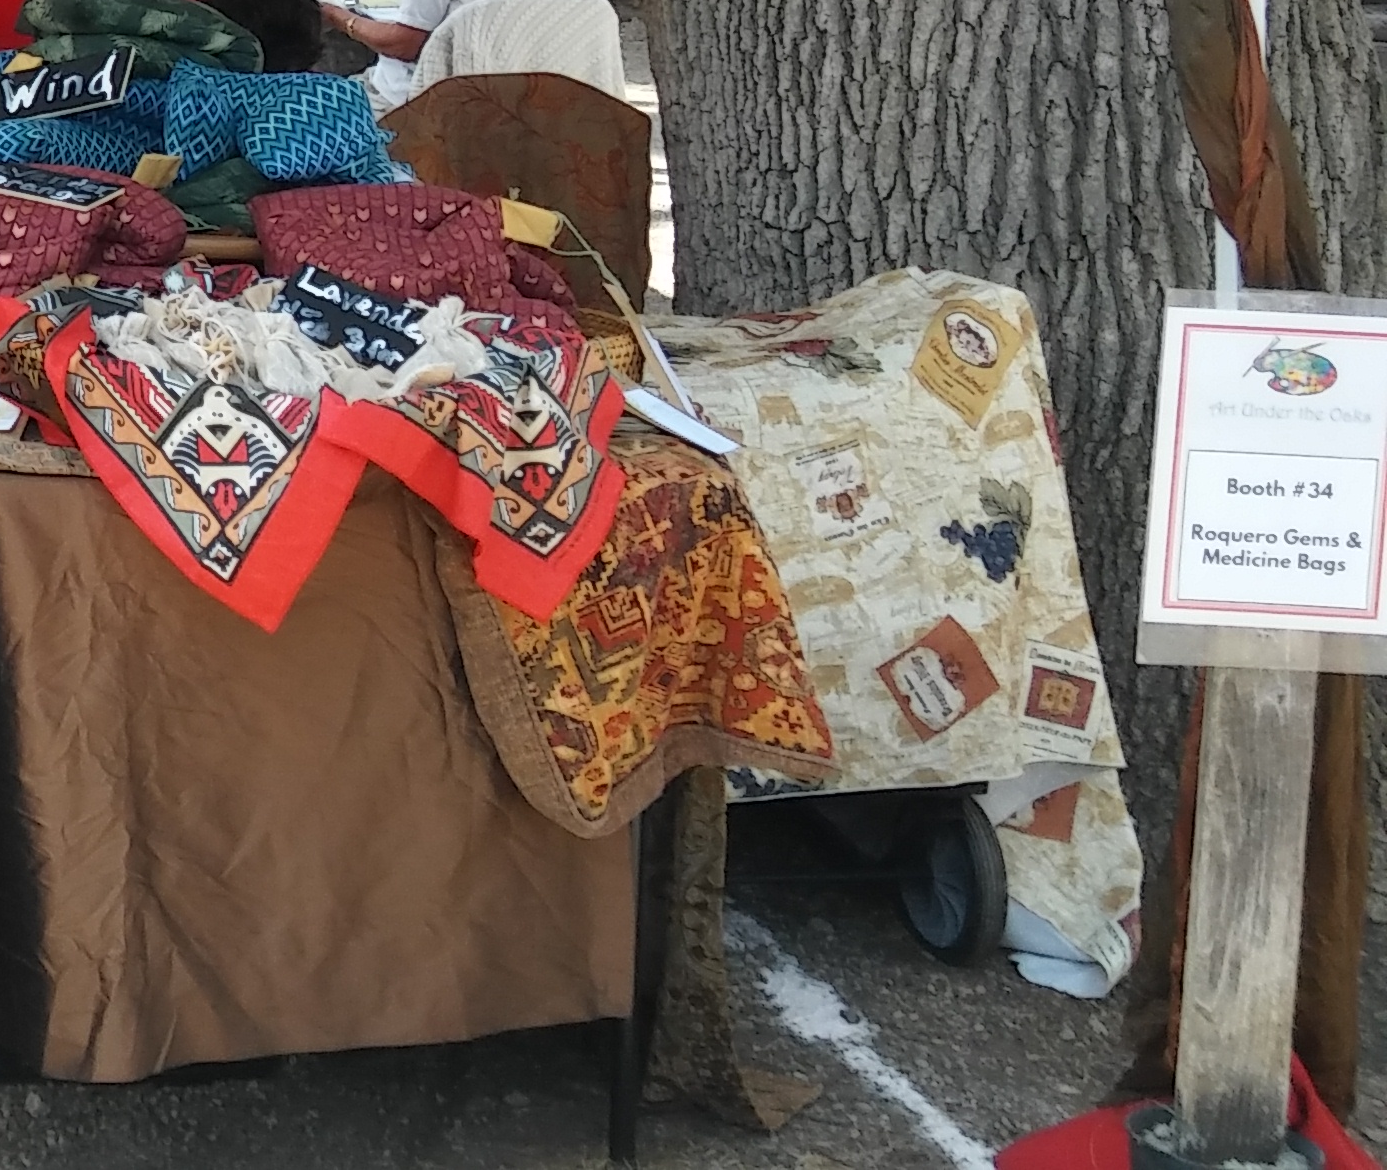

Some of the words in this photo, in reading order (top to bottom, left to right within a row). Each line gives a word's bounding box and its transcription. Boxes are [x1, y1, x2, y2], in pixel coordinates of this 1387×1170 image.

[1, 52, 115, 113] Wind
[1227, 477, 1286, 497] Booth
[1293, 481, 1334, 500] #34
[1191, 523, 1278, 547] Roquero
[1283, 528, 1340, 548] Gems
[1345, 531, 1363, 549] &
[1202, 548, 1292, 569] Medicine
[1297, 553, 1347, 576] Bags
